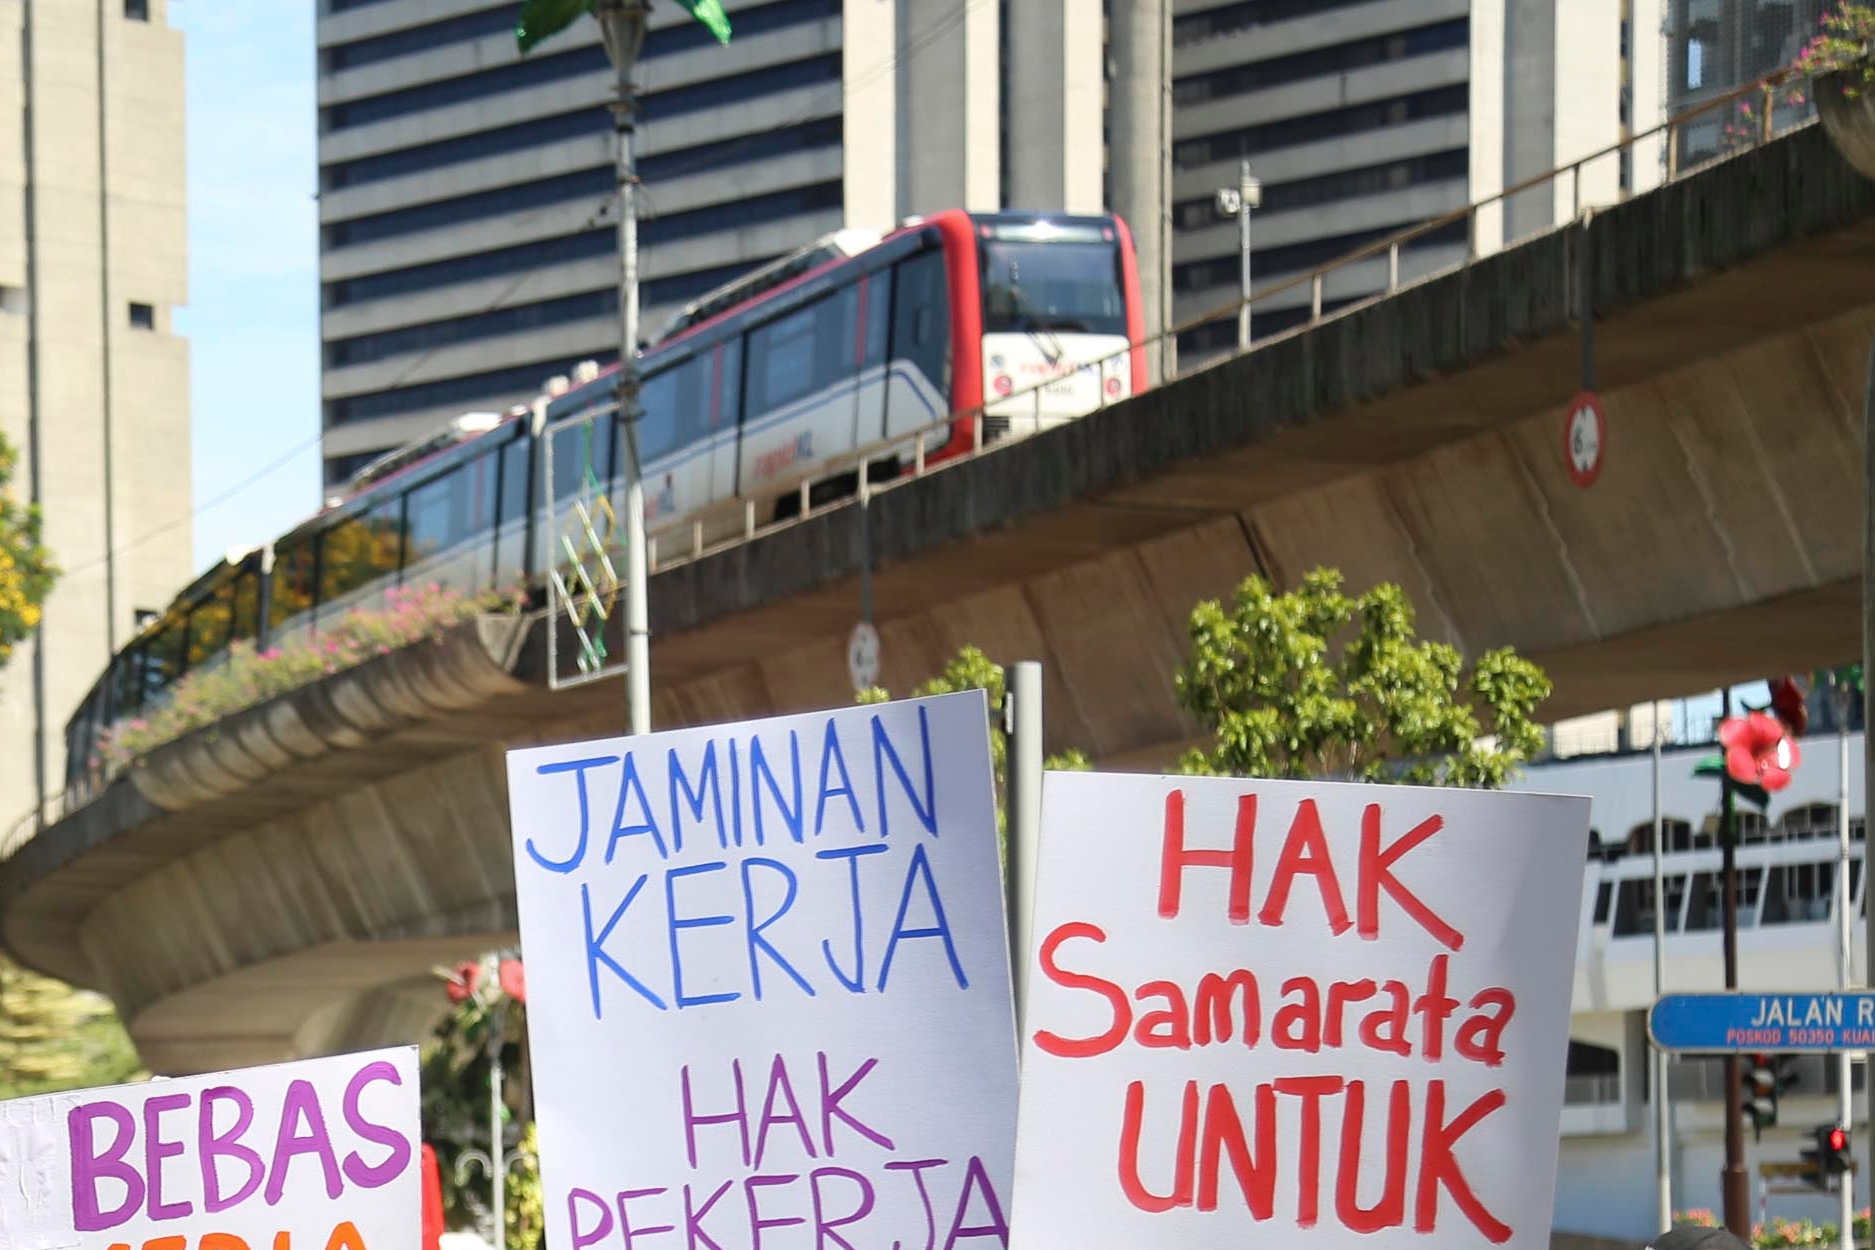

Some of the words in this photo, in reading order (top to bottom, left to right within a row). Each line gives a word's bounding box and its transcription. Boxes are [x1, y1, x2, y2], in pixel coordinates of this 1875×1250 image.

[525, 705, 940, 875] JAMINAN
[1158, 789, 1464, 952] HAK
[581, 843, 970, 1019] KERJA
[1033, 921, 1516, 1067] Samarata
[1751, 998, 1843, 1027] JALAN
[680, 1051, 896, 1171] HAK
[1727, 1029, 1781, 1045] POSKOD
[67, 1060, 412, 1233] BEBAS
[1118, 1075, 1514, 1244] UNTUK
